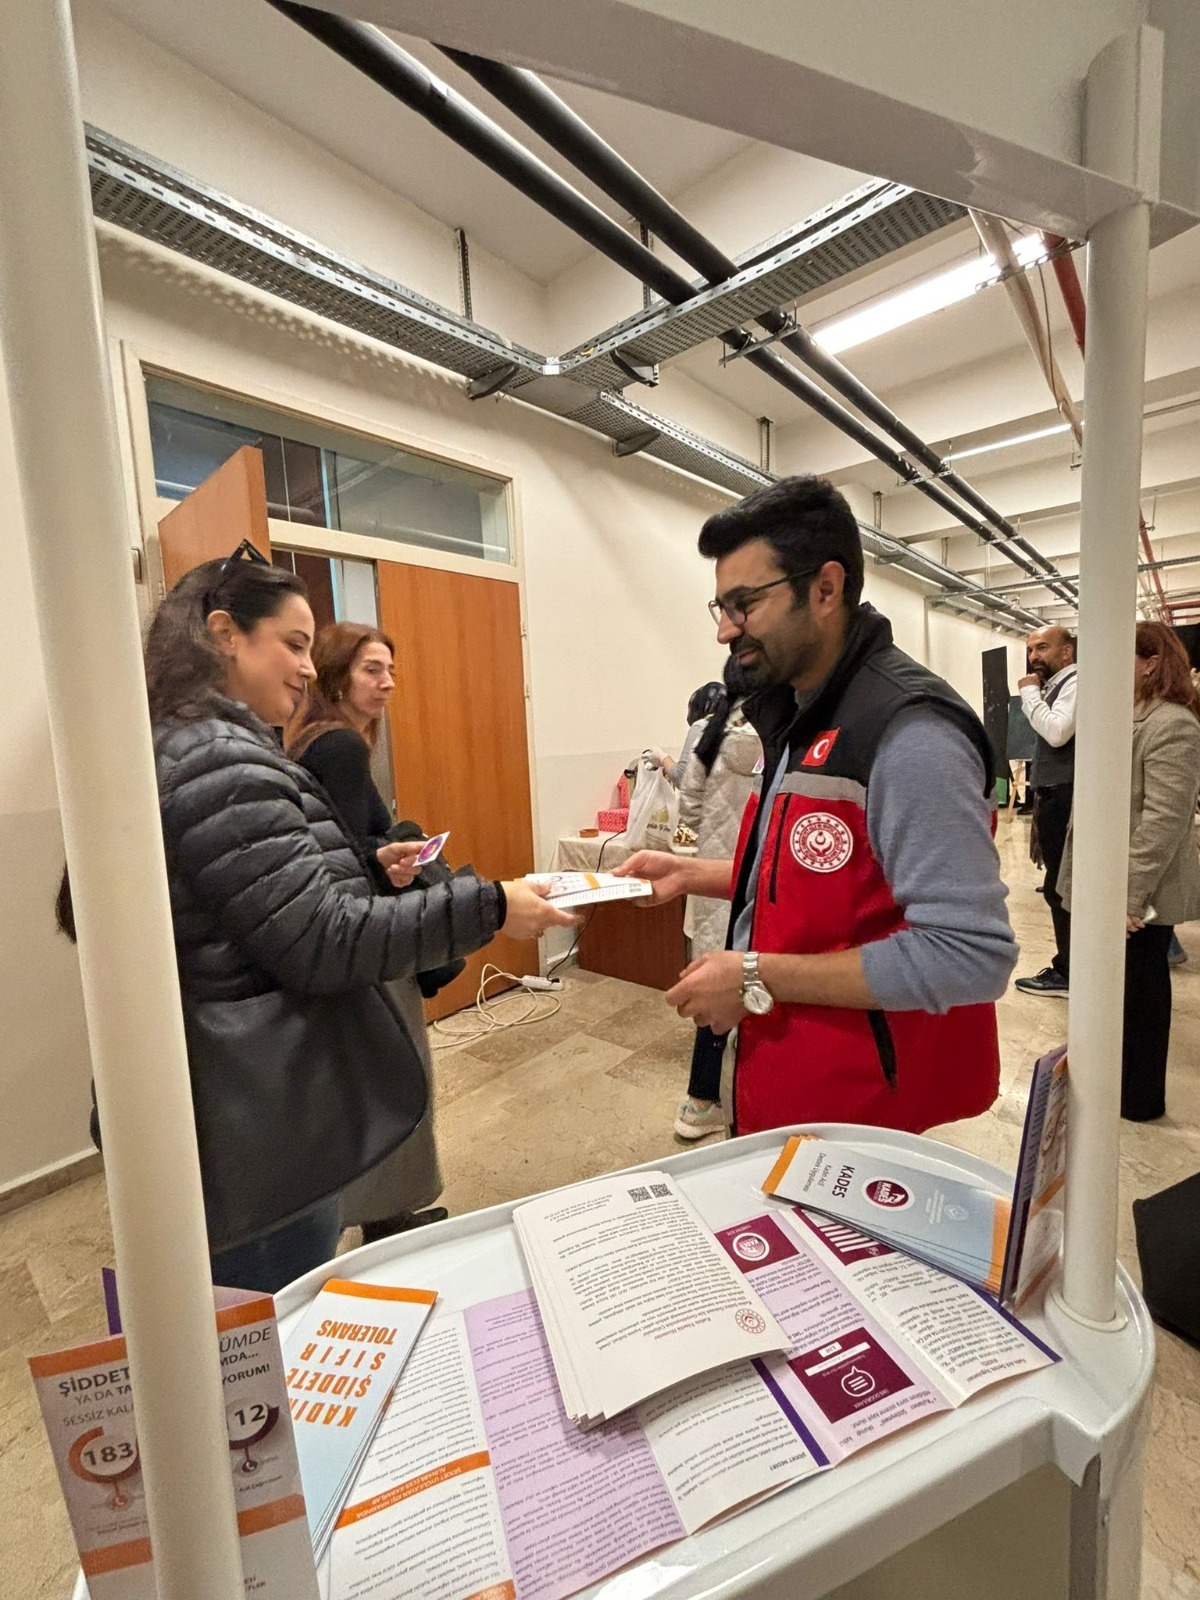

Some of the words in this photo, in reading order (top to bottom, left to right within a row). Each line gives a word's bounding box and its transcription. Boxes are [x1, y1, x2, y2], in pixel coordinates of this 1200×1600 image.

[832, 1165, 854, 1197] KADES
[878, 1182, 891, 1201] KADES
[317, 1319, 399, 1346] TOLERANS
[58, 1366, 130, 1394] ŞİDDET
[285, 1368, 373, 1400] ŞİDDETE
[75, 1393, 91, 1404] YA
[94, 1388, 113, 1400] DA
[63, 1409, 104, 1426] SESSİZ
[106, 1403, 134, 1417] KAL
[82, 1441, 134, 1467] 183
